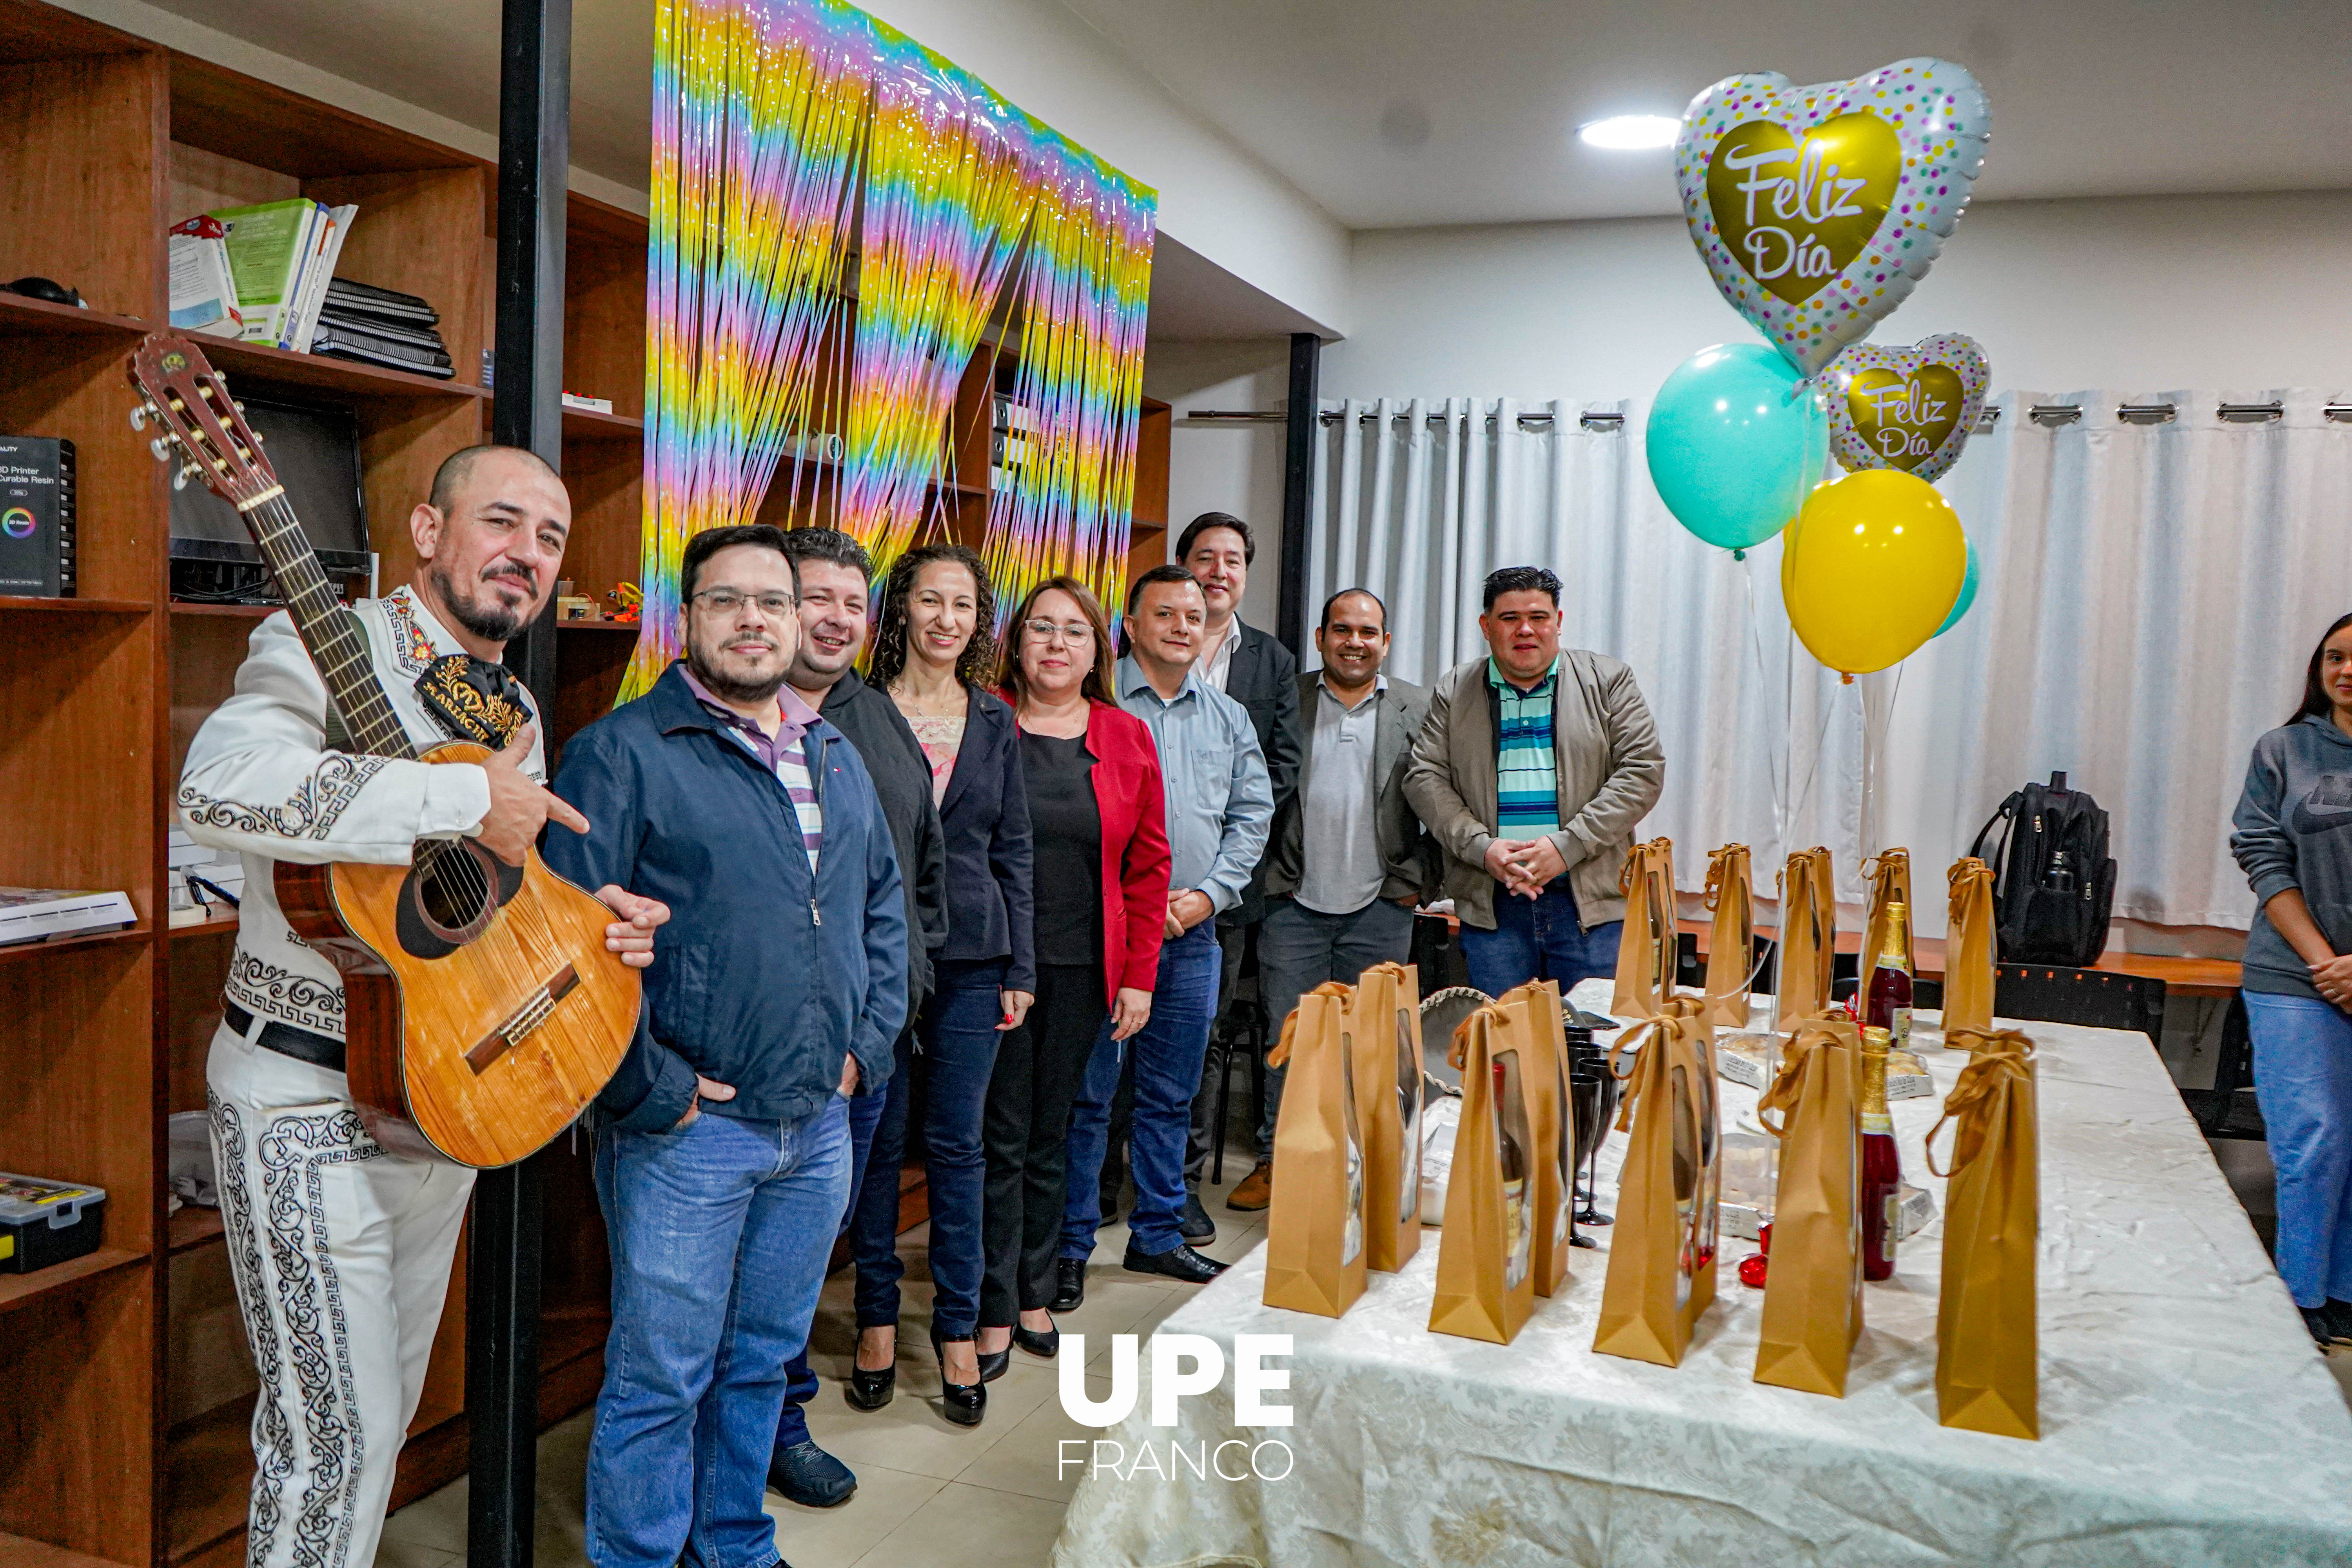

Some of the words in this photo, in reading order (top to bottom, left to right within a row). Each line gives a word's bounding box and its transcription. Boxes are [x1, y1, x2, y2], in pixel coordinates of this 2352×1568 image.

[1724, 137, 1867, 226] Feliz
[1744, 225, 1838, 279] Día
[1860, 379, 1947, 426] Feliz
[1877, 427, 1932, 457] Día
[31, 476, 54, 484] Resin
[423, 681, 490, 742] MARIACHI
